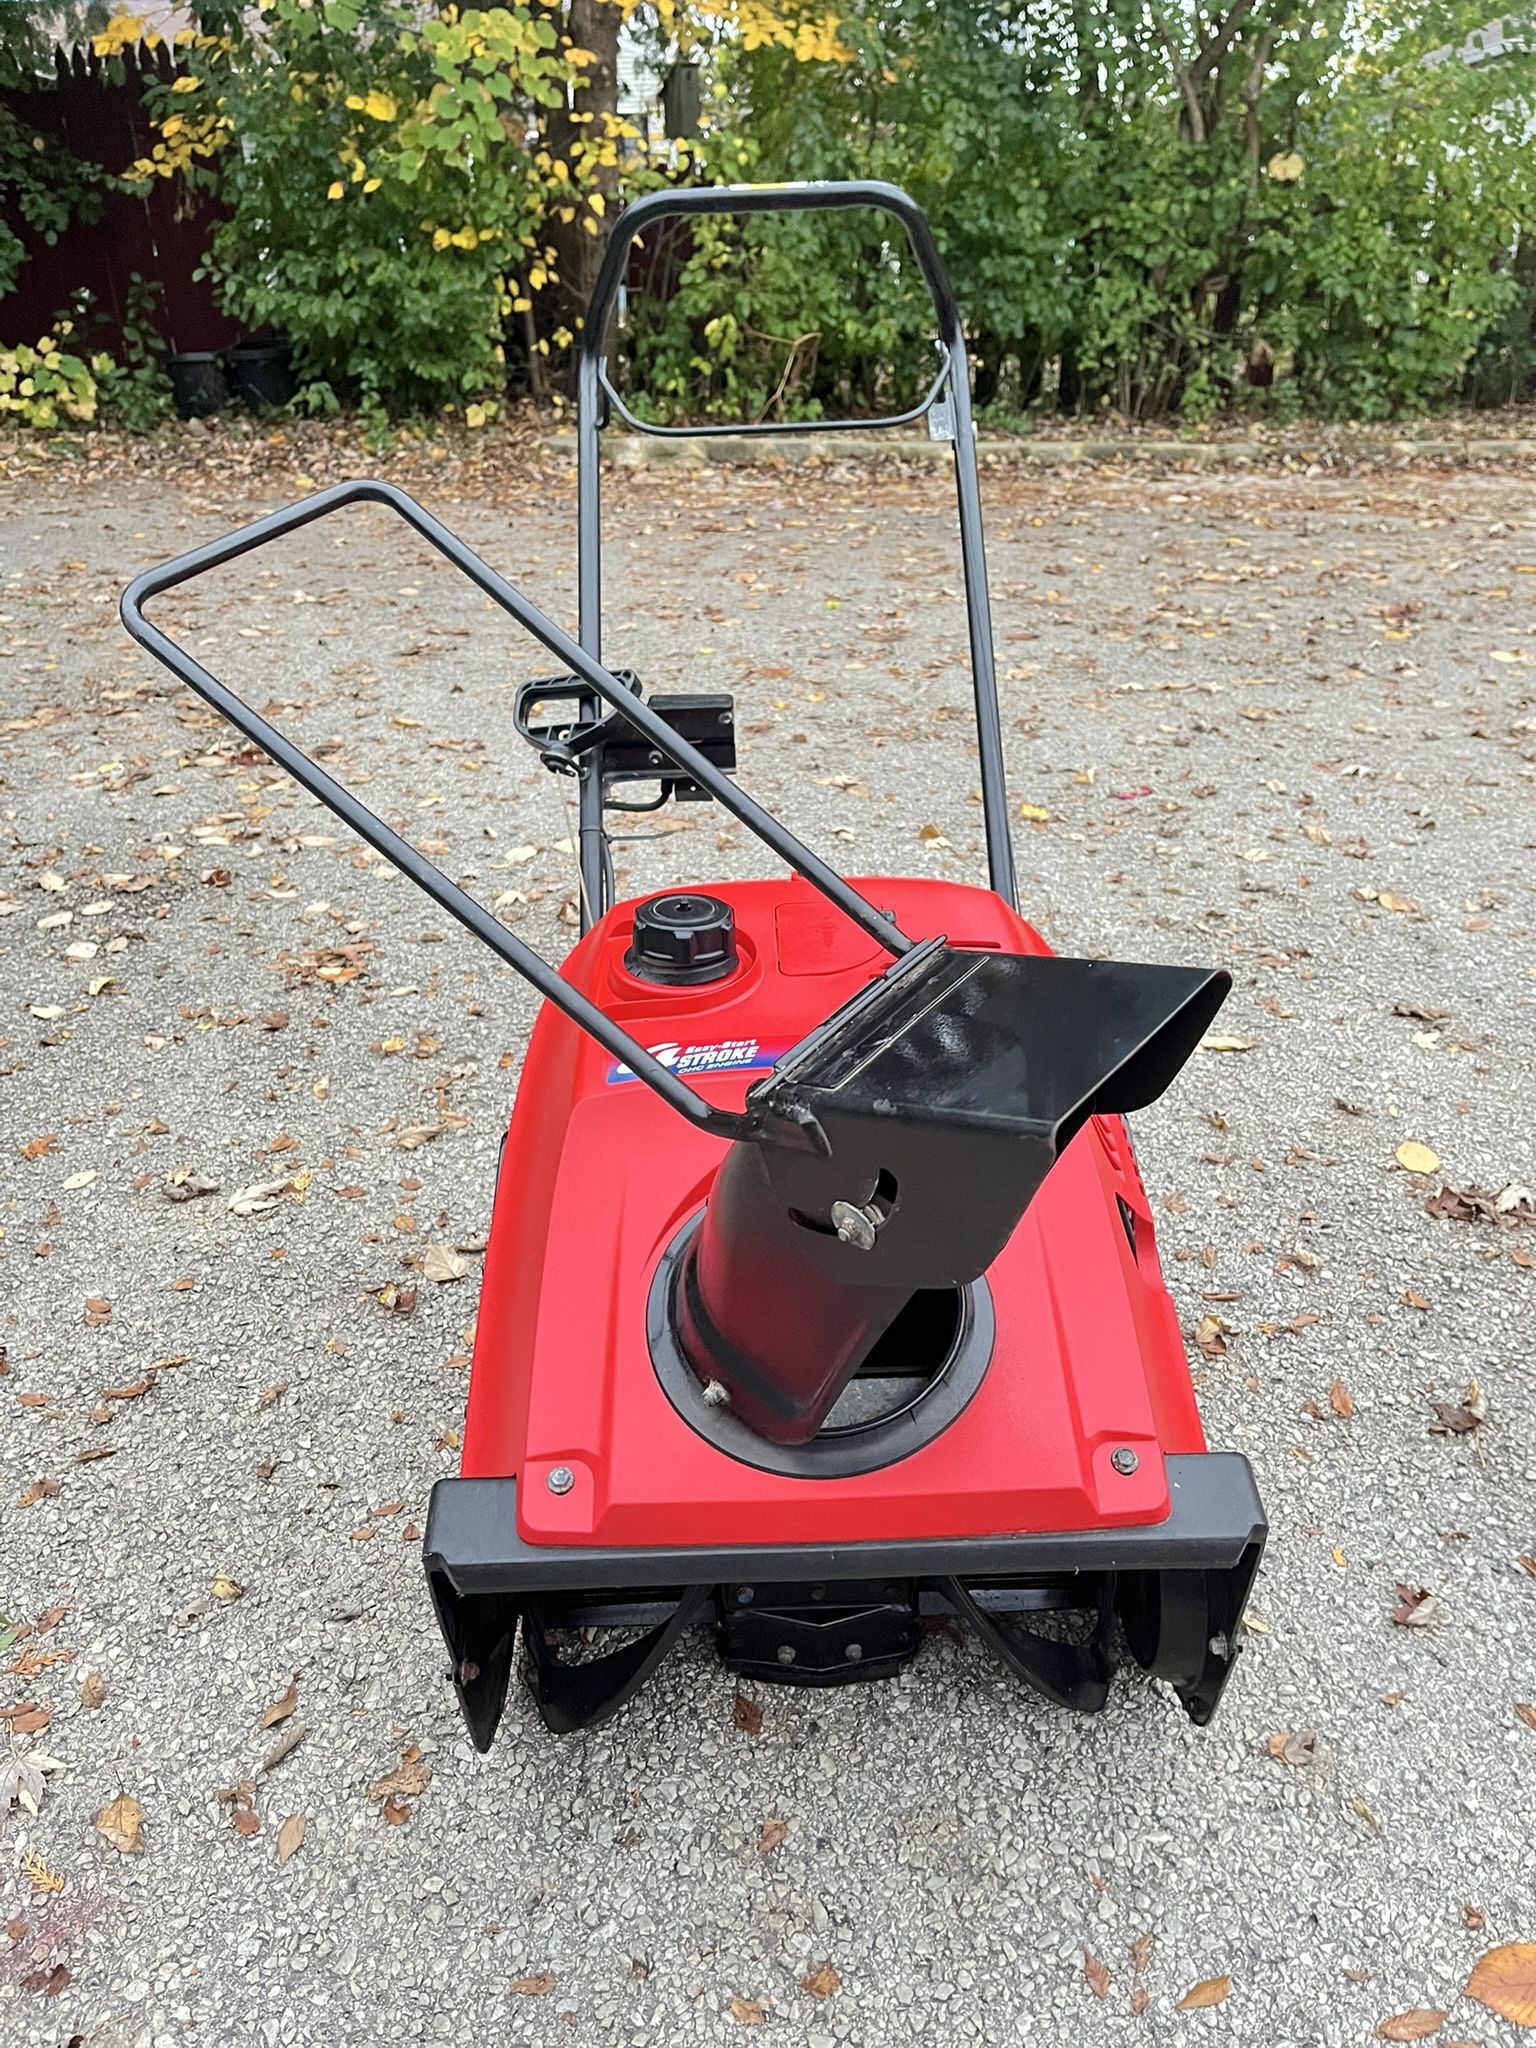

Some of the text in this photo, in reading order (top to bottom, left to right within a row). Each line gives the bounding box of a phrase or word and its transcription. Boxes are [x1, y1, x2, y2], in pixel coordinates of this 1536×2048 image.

[684, 1039, 757, 1055] Easy-Start
[676, 1046, 760, 1069] STROKE
[678, 1058, 753, 1074] OHC ENGINE
